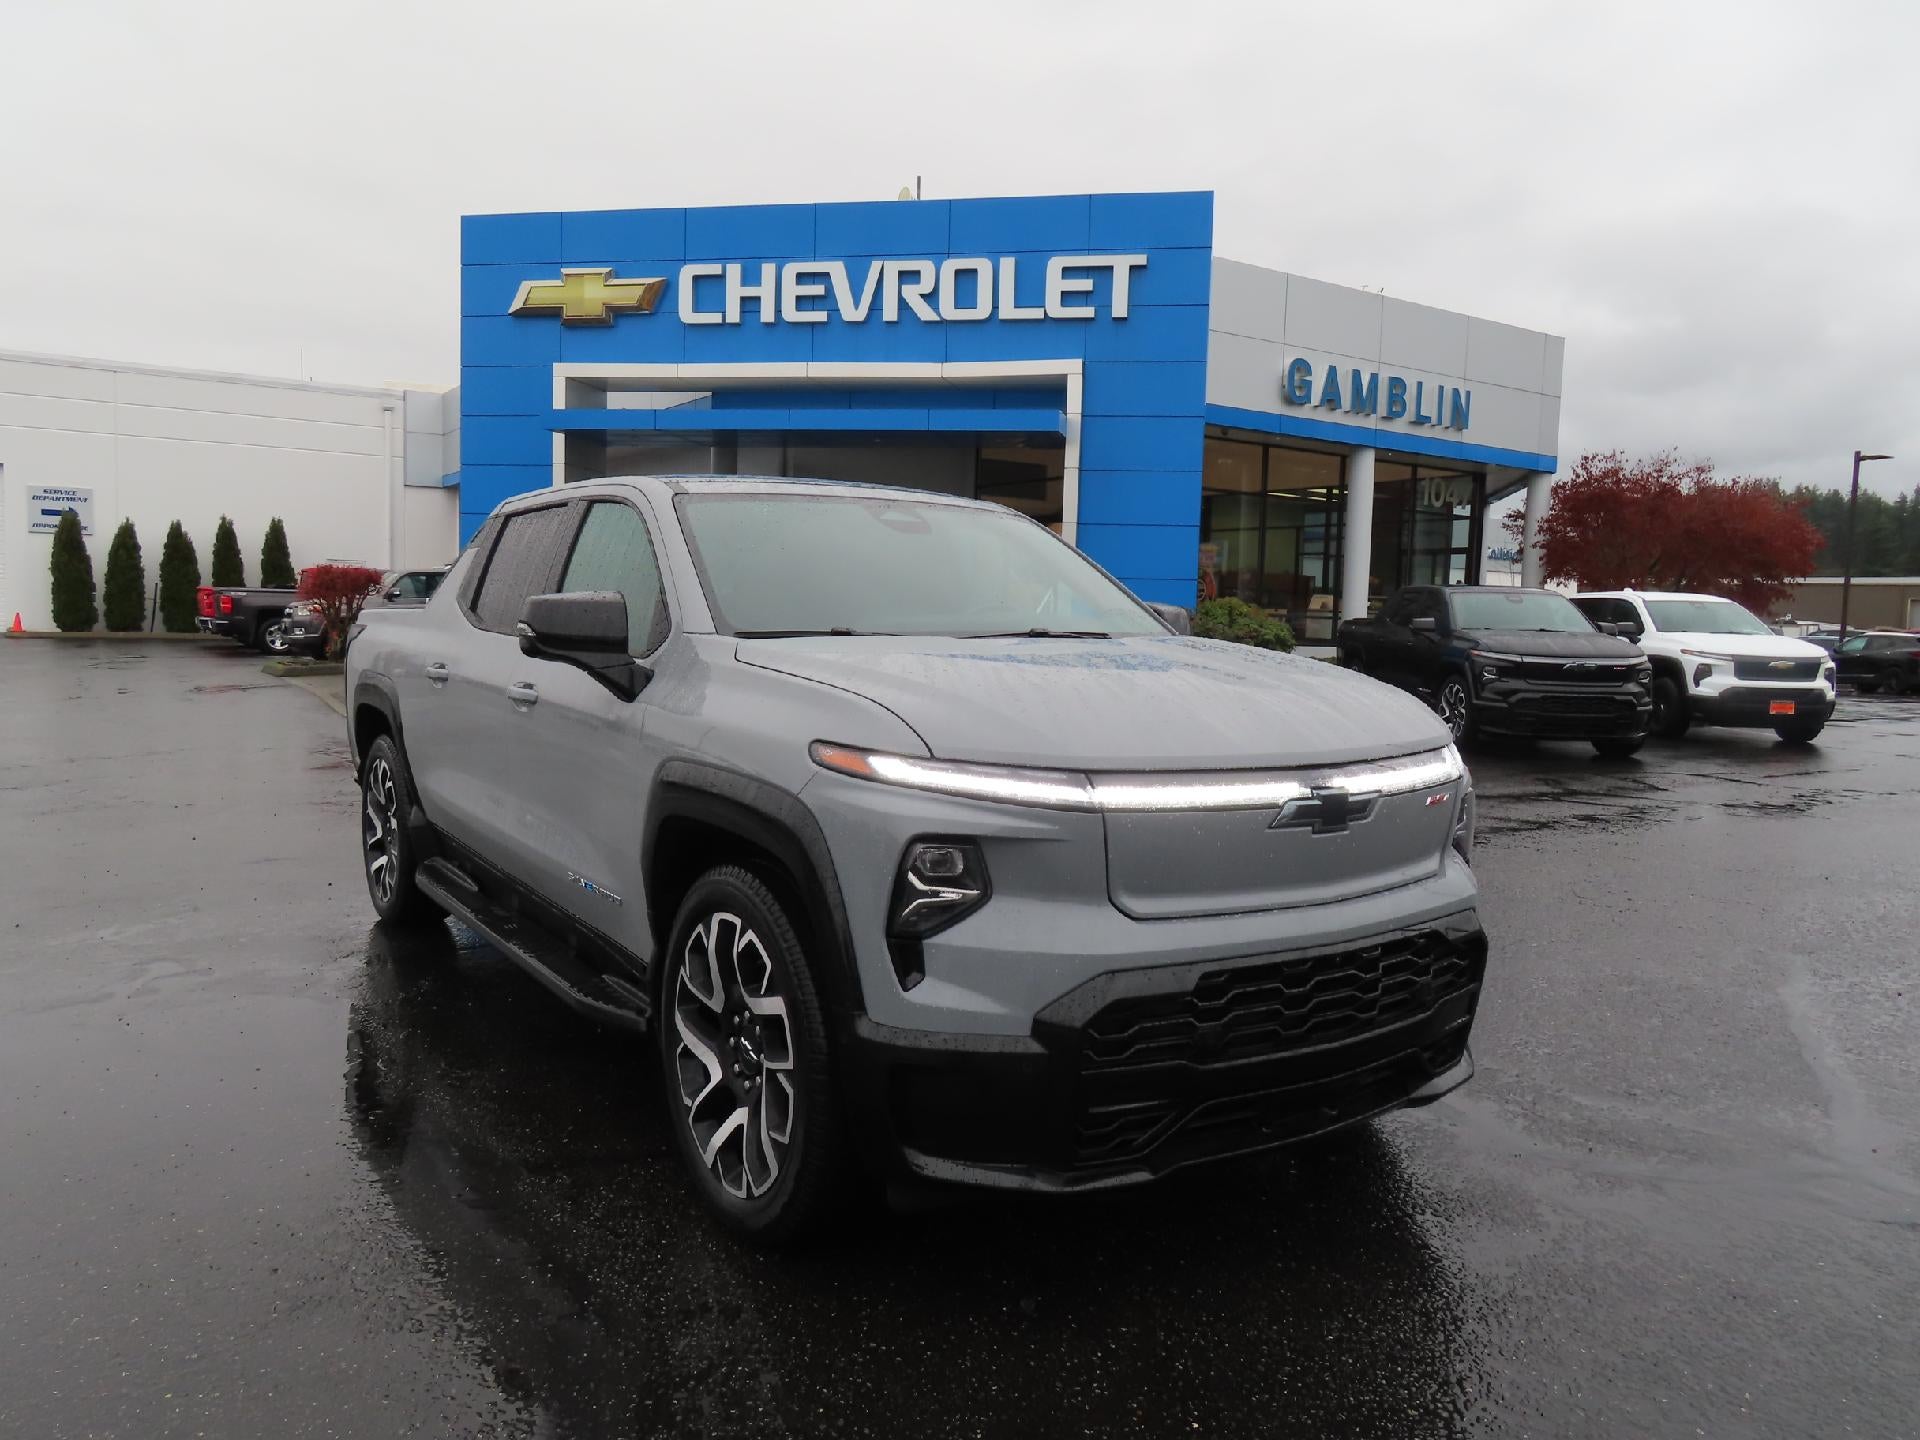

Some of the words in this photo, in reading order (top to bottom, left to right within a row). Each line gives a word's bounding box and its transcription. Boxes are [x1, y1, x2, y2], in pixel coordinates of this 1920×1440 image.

[678, 254, 1148, 324] CHEVROLET
[1285, 357, 1471, 430] GAMBLIN
[32, 494, 88, 503] DEPARTMENT
[43, 488, 78, 497] SERVICE
